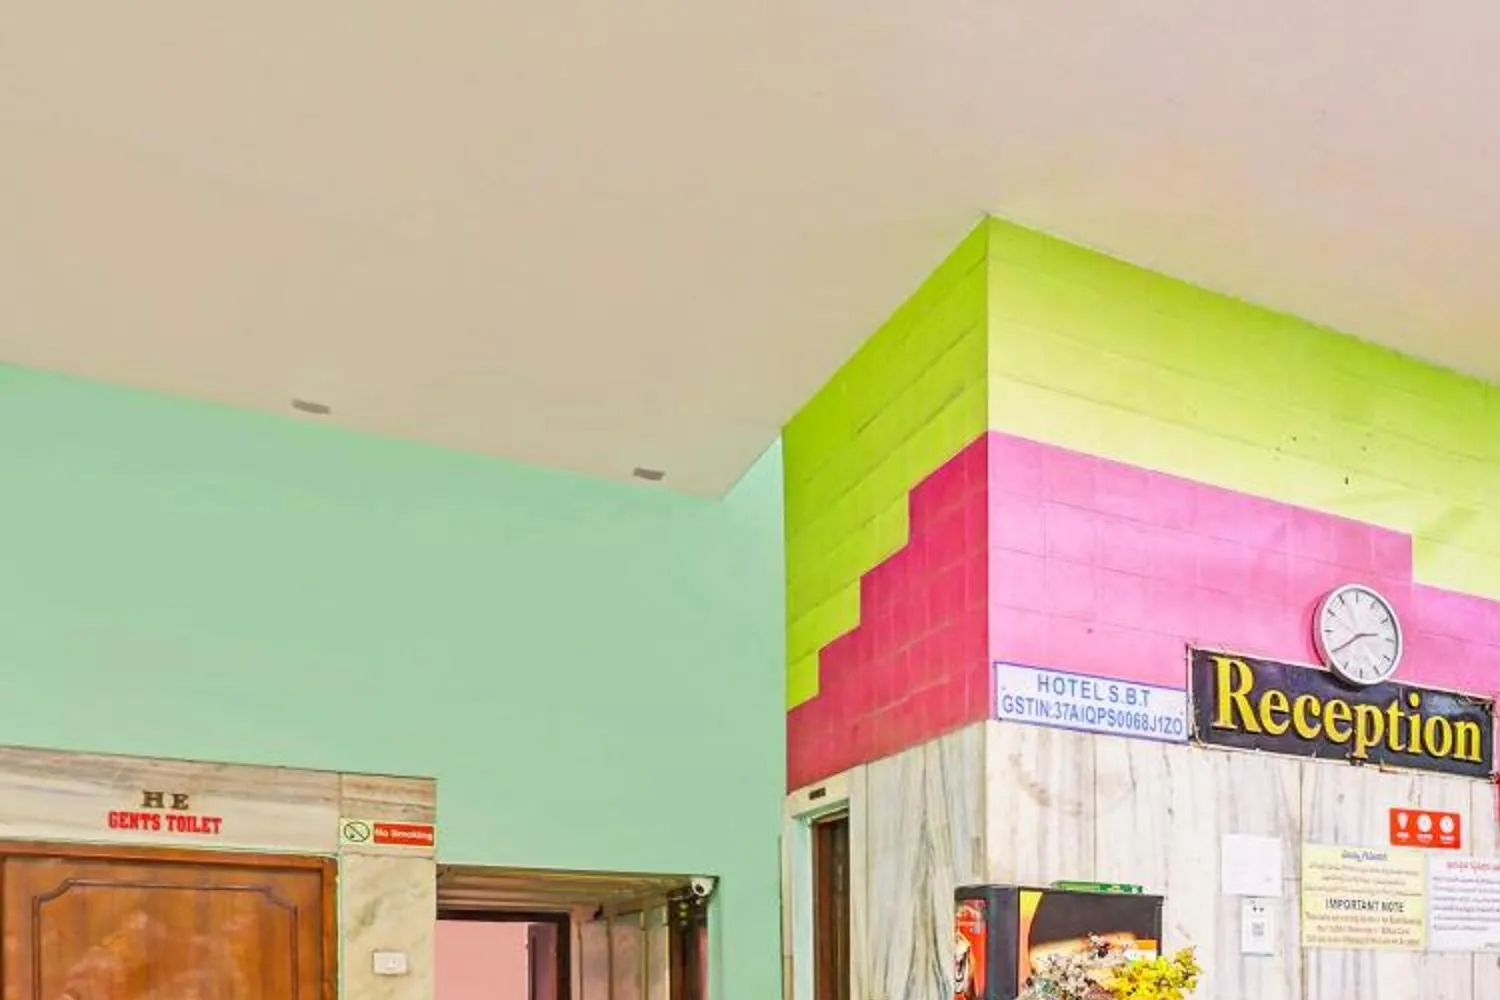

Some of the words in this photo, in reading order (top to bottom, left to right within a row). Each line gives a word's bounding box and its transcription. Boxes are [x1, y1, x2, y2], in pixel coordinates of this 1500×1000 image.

[1037, 673, 1104, 701] HOTEL
[1108, 684, 1151, 708] S.B.T
[1208, 655, 1483, 763] Reception
[107, 811, 161, 832] GENTS
[166, 814, 223, 835] TOILET
[391, 829, 433, 842] Smoking
[1325, 898, 1380, 911] IMPORTANT
[1381, 901, 1405, 913] NOTE
